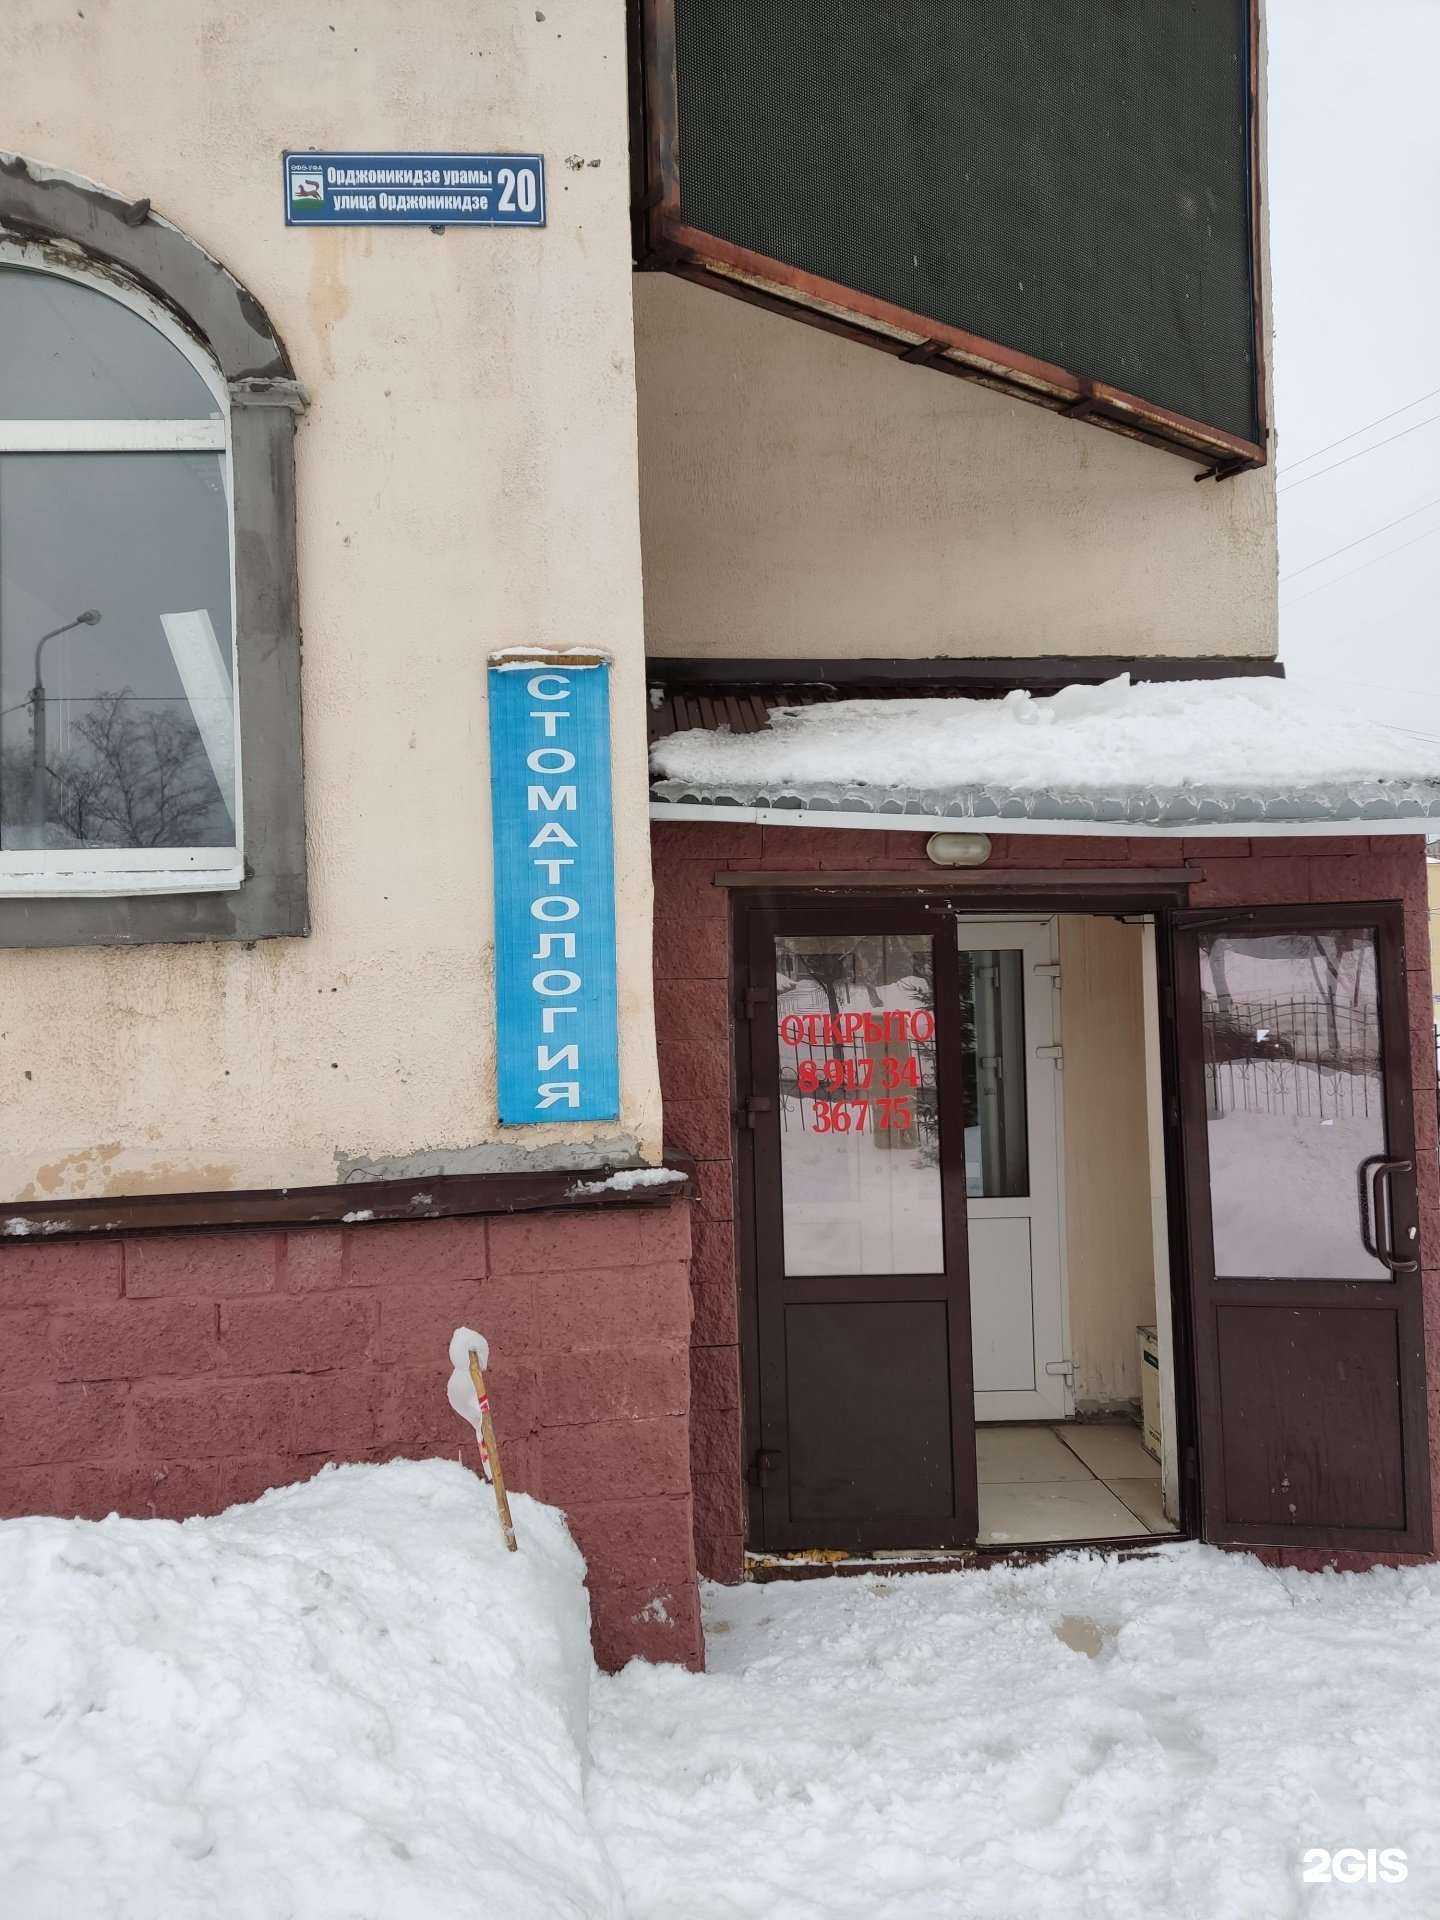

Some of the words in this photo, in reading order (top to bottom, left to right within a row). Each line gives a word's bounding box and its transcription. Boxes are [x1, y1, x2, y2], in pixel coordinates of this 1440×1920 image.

[327, 166, 440, 185] Орджоникидзе
[443, 169, 492, 185] урамы
[497, 168, 536, 212] 20
[333, 194, 376, 211] улица
[379, 193, 488, 211] Орджоникидзе
[526, 674, 582, 1109] СТОМАТОЛОГИЯ
[780, 1009, 936, 1046] ОТКРЫТО
[881, 1056, 920, 1089] 34
[812, 1099, 869, 1133] 367
[875, 1096, 912, 1130] 75
